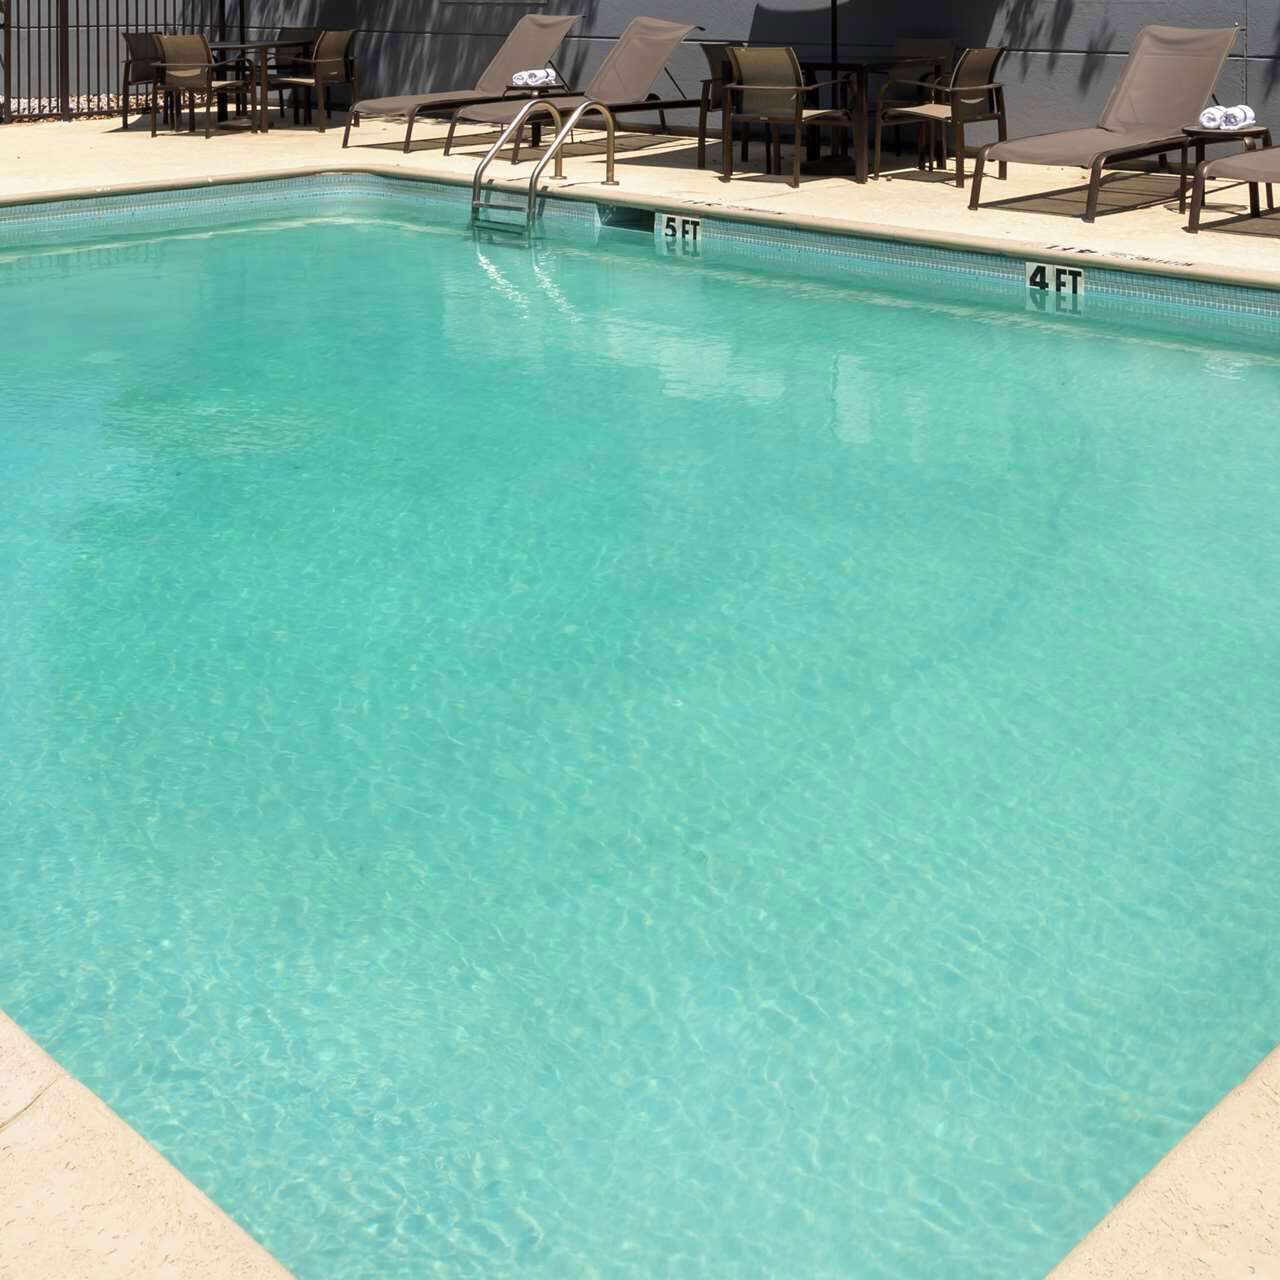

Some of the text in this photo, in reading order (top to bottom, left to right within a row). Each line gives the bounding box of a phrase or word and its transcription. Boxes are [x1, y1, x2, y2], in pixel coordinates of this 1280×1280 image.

[665, 217, 700, 240] 5 FT
[1029, 265, 1082, 295] 4 FT
